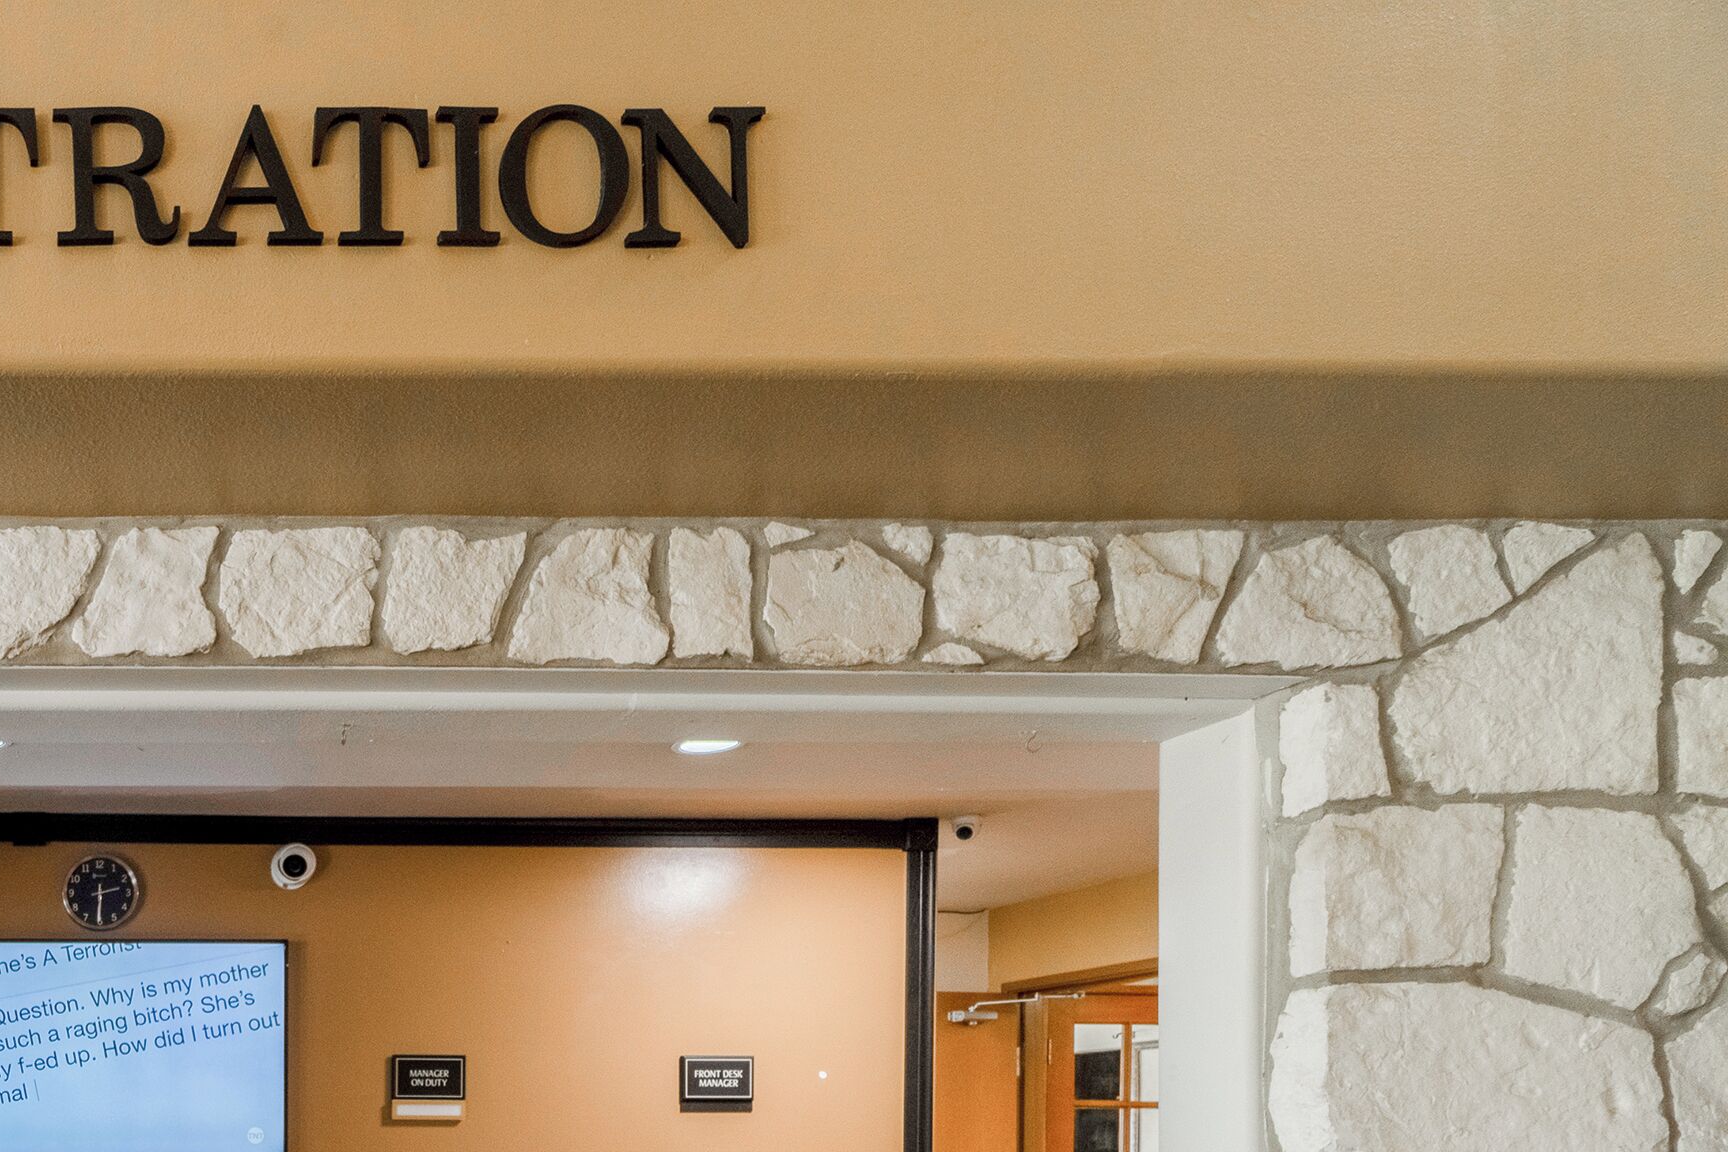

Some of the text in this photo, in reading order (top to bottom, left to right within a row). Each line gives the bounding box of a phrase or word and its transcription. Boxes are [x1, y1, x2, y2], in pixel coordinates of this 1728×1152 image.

[43, 949, 58, 967] A
[90, 986, 134, 1006] Why
[140, 982, 157, 999] is
[163, 977, 192, 995] my
[199, 962, 269, 988] mother
[48, 1028, 61, 1042] a
[66, 1016, 128, 1040] raging
[133, 999, 193, 1027] bitch?
[201, 990, 255, 1014] She's
[18, 1051, 59, 1074] f-ed
[65, 1048, 97, 1067] up.
[102, 1038, 147, 1058] How
[154, 1028, 185, 1049] did
[191, 1025, 197, 1042] I
[202, 1020, 242, 1040] turn
[248, 1011, 281, 1032] out
[409, 1069, 450, 1078] MANAGER
[694, 1069, 743, 1078] FRONT DESK
[411, 1079, 448, 1087] ON DUTY
[698, 1079, 739, 1088] MANAGER
